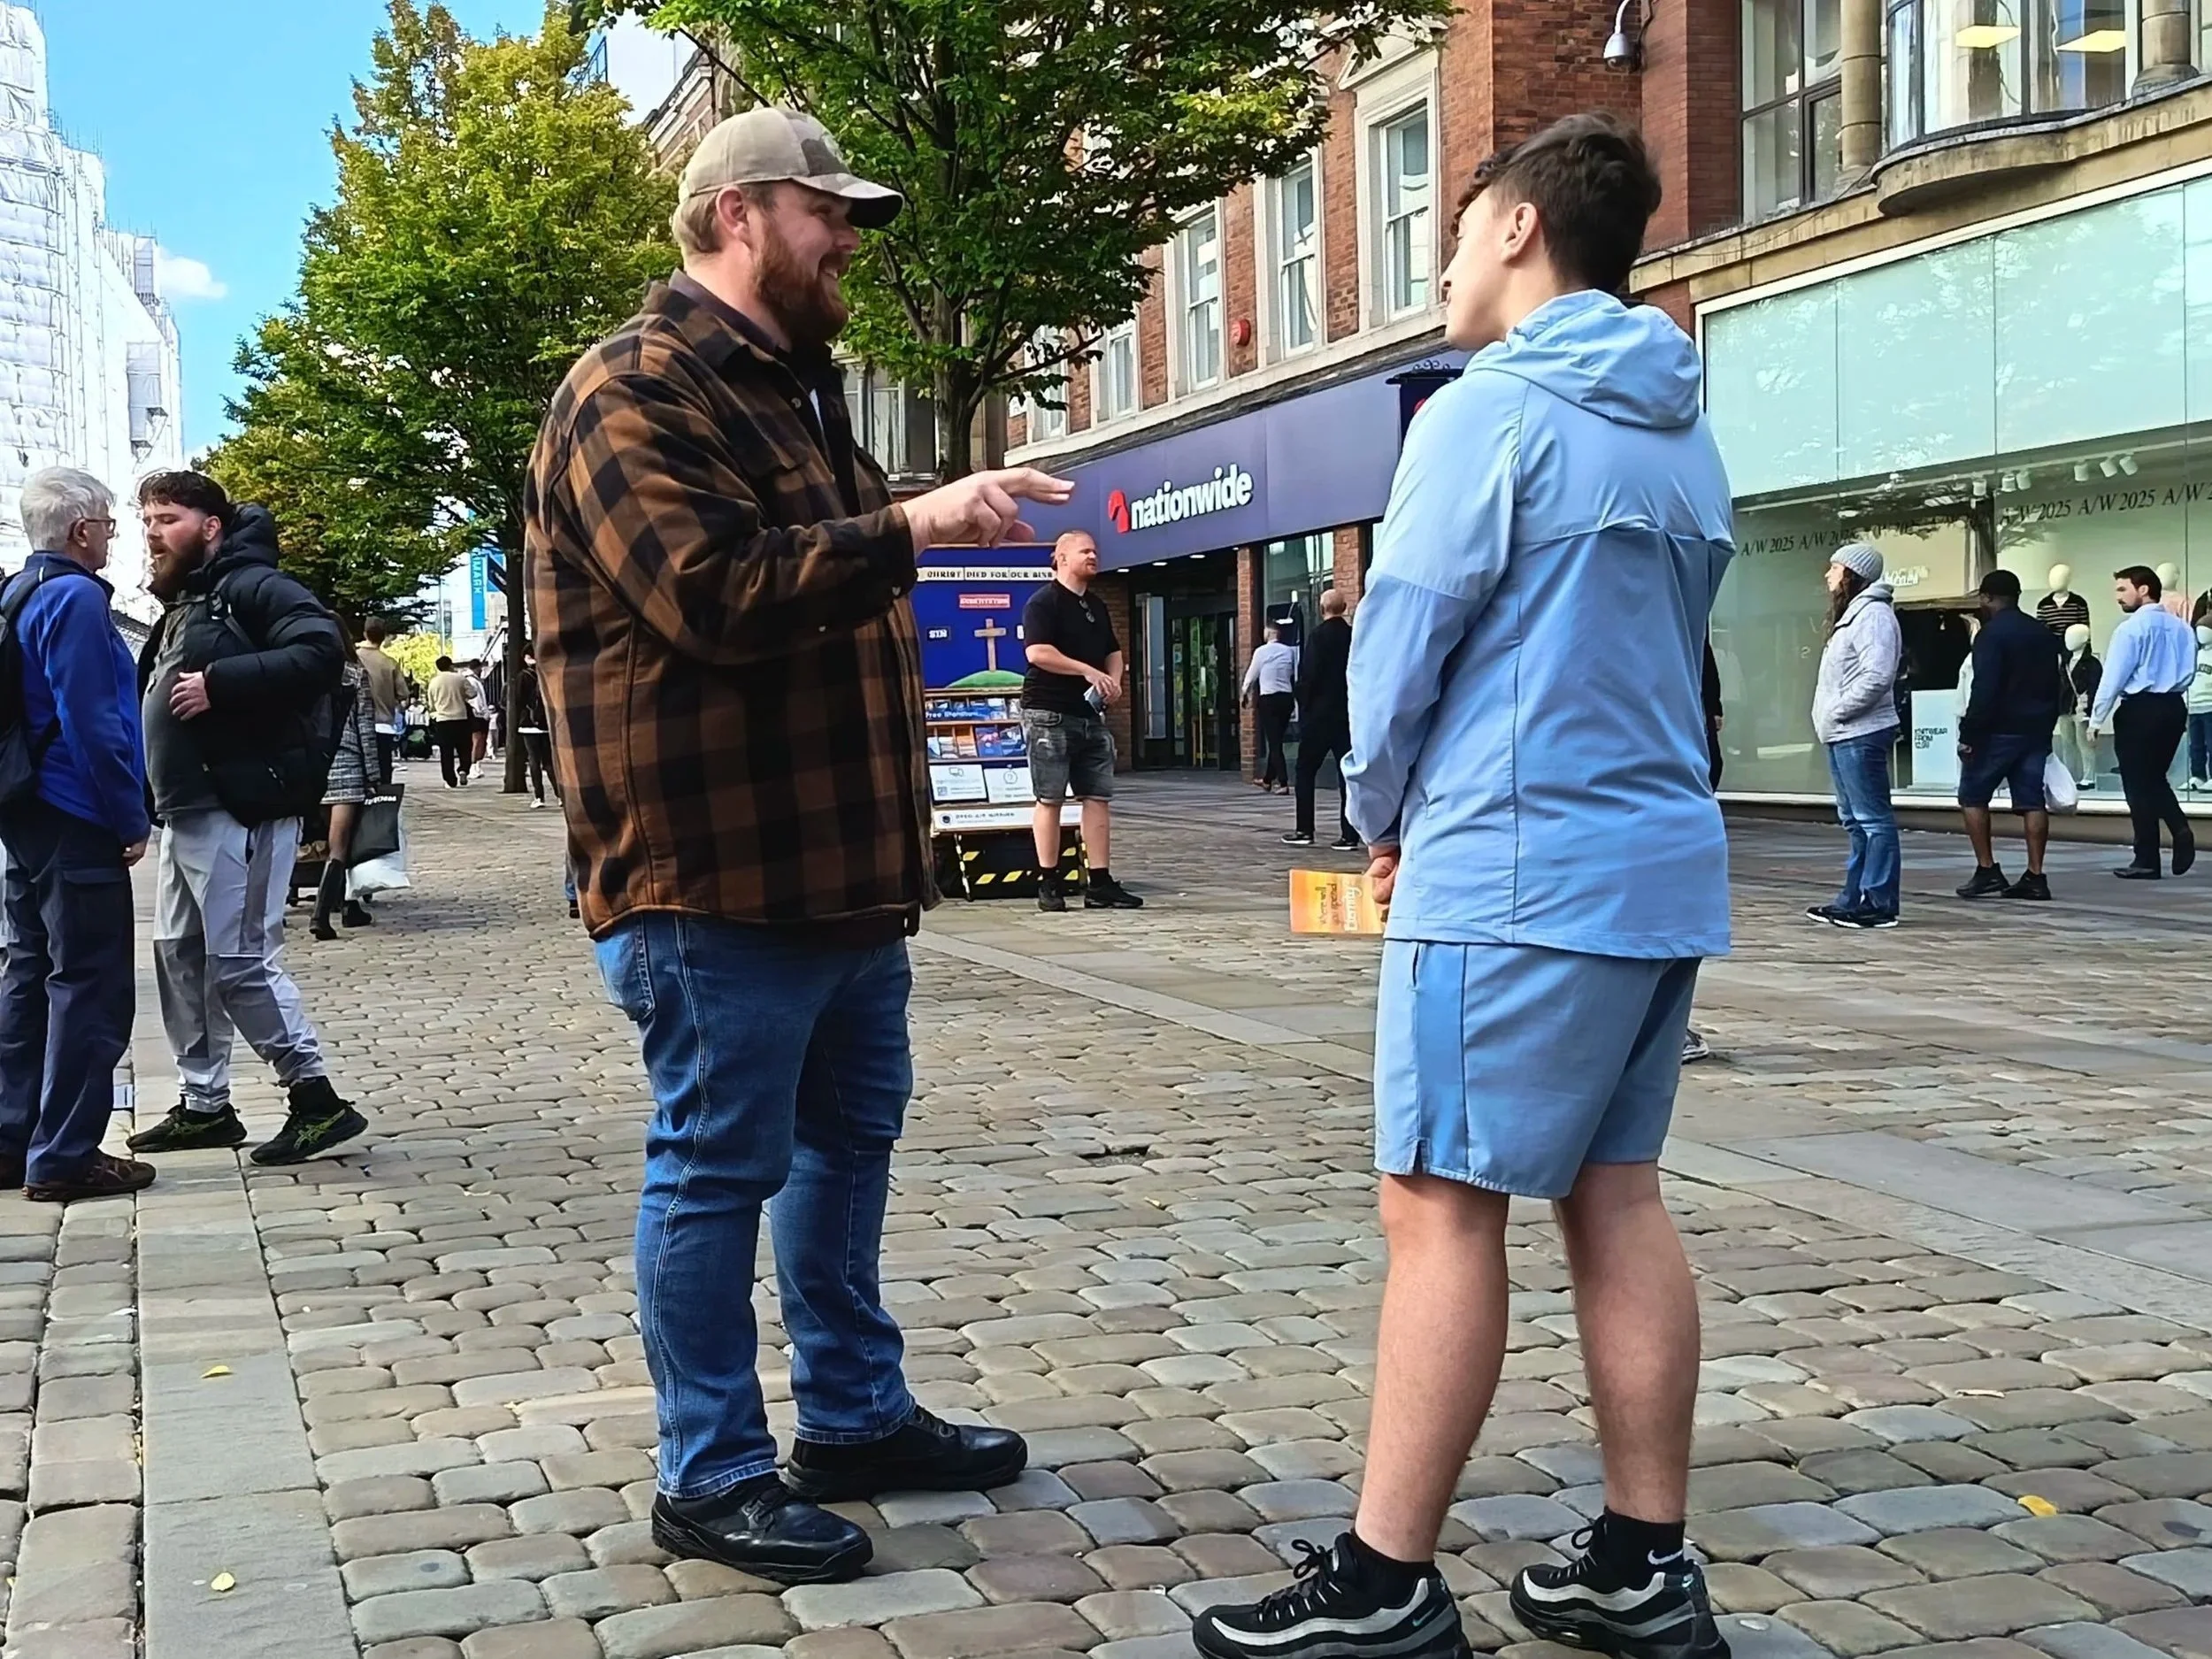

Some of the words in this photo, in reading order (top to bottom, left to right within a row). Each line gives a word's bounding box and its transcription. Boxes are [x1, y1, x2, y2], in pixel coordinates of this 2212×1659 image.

[1132, 464, 1252, 530] nationwide
[2037, 500, 2071, 520] 2025
[2078, 494, 2117, 516] A/W
[2119, 489, 2156, 511] 2025
[2162, 482, 2204, 506] A/W
[1741, 538, 1768, 557] A/W
[1770, 535, 1794, 553] 2025
[1799, 531, 1828, 550] A/W
[929, 628, 947, 639] SIN
